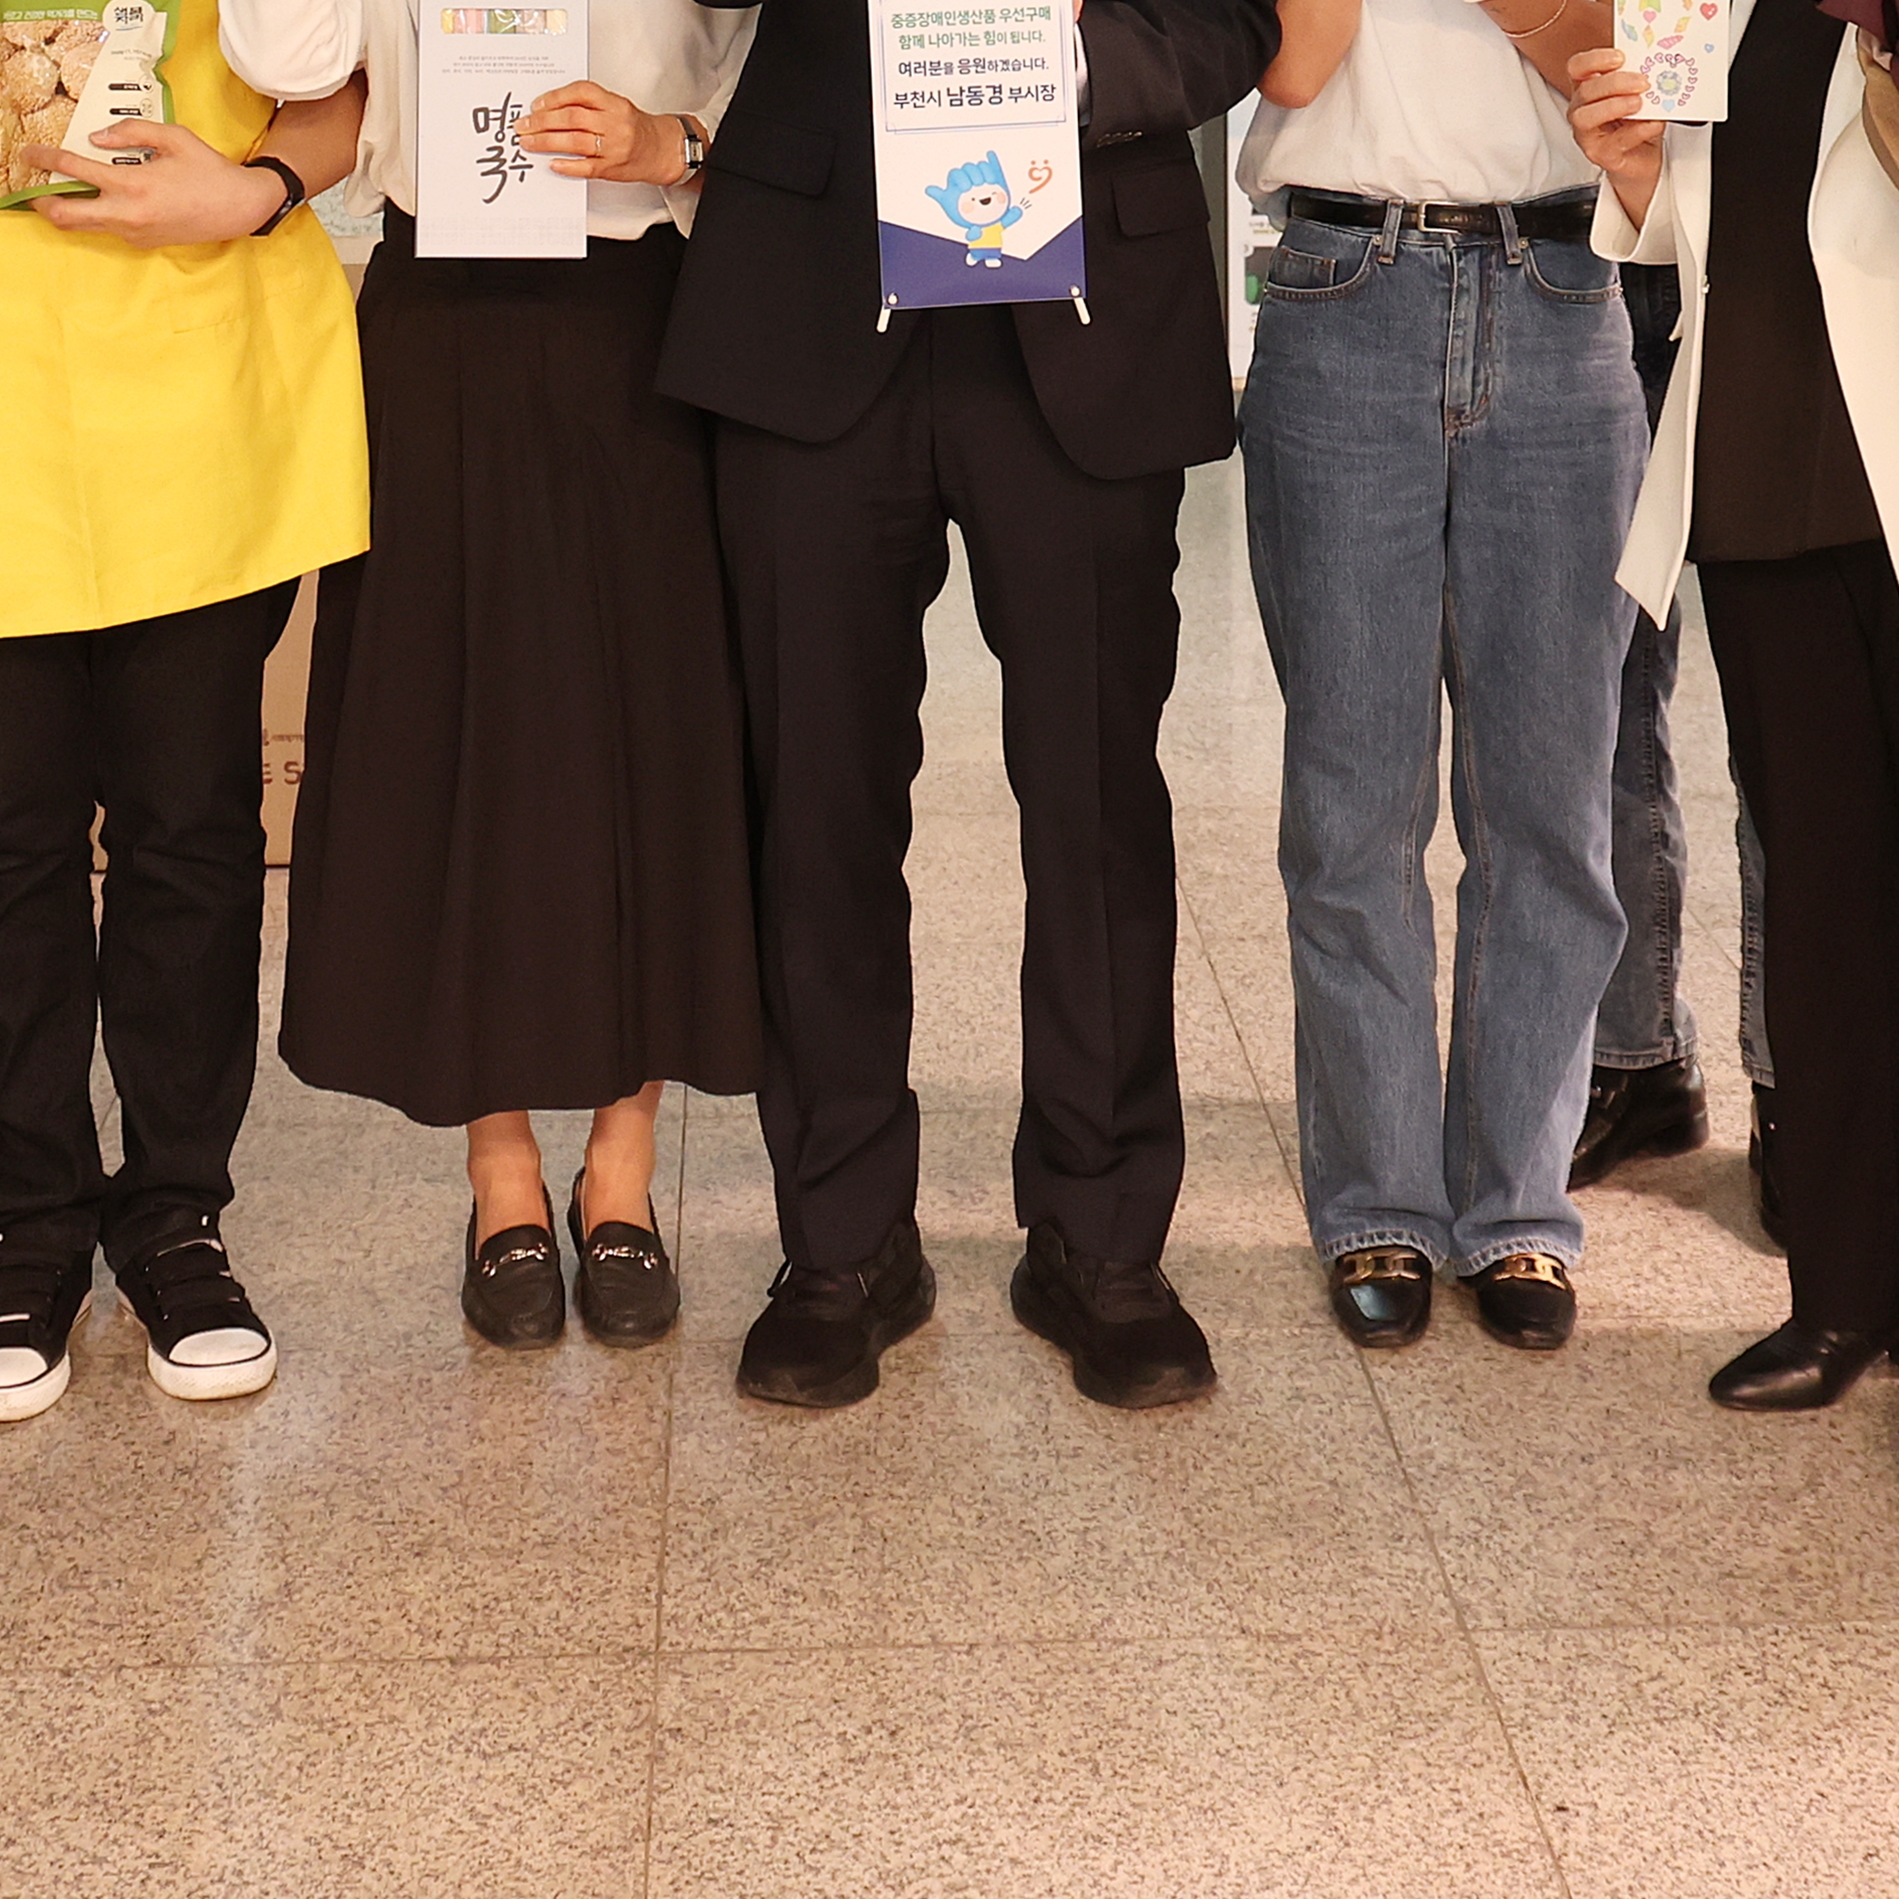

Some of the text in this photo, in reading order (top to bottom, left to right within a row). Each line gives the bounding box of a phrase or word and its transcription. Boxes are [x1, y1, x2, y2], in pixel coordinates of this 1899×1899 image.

[891, 5, 1051, 29] 중증장애인생산품 우선구매
[899, 30, 1046, 50] 함께 나아가는 힘이 됩니다.
[898, 57, 1049, 78] 여러분을 응원하겠습니다.
[893, 83, 1057, 109] 부천시 남동경 부시장
